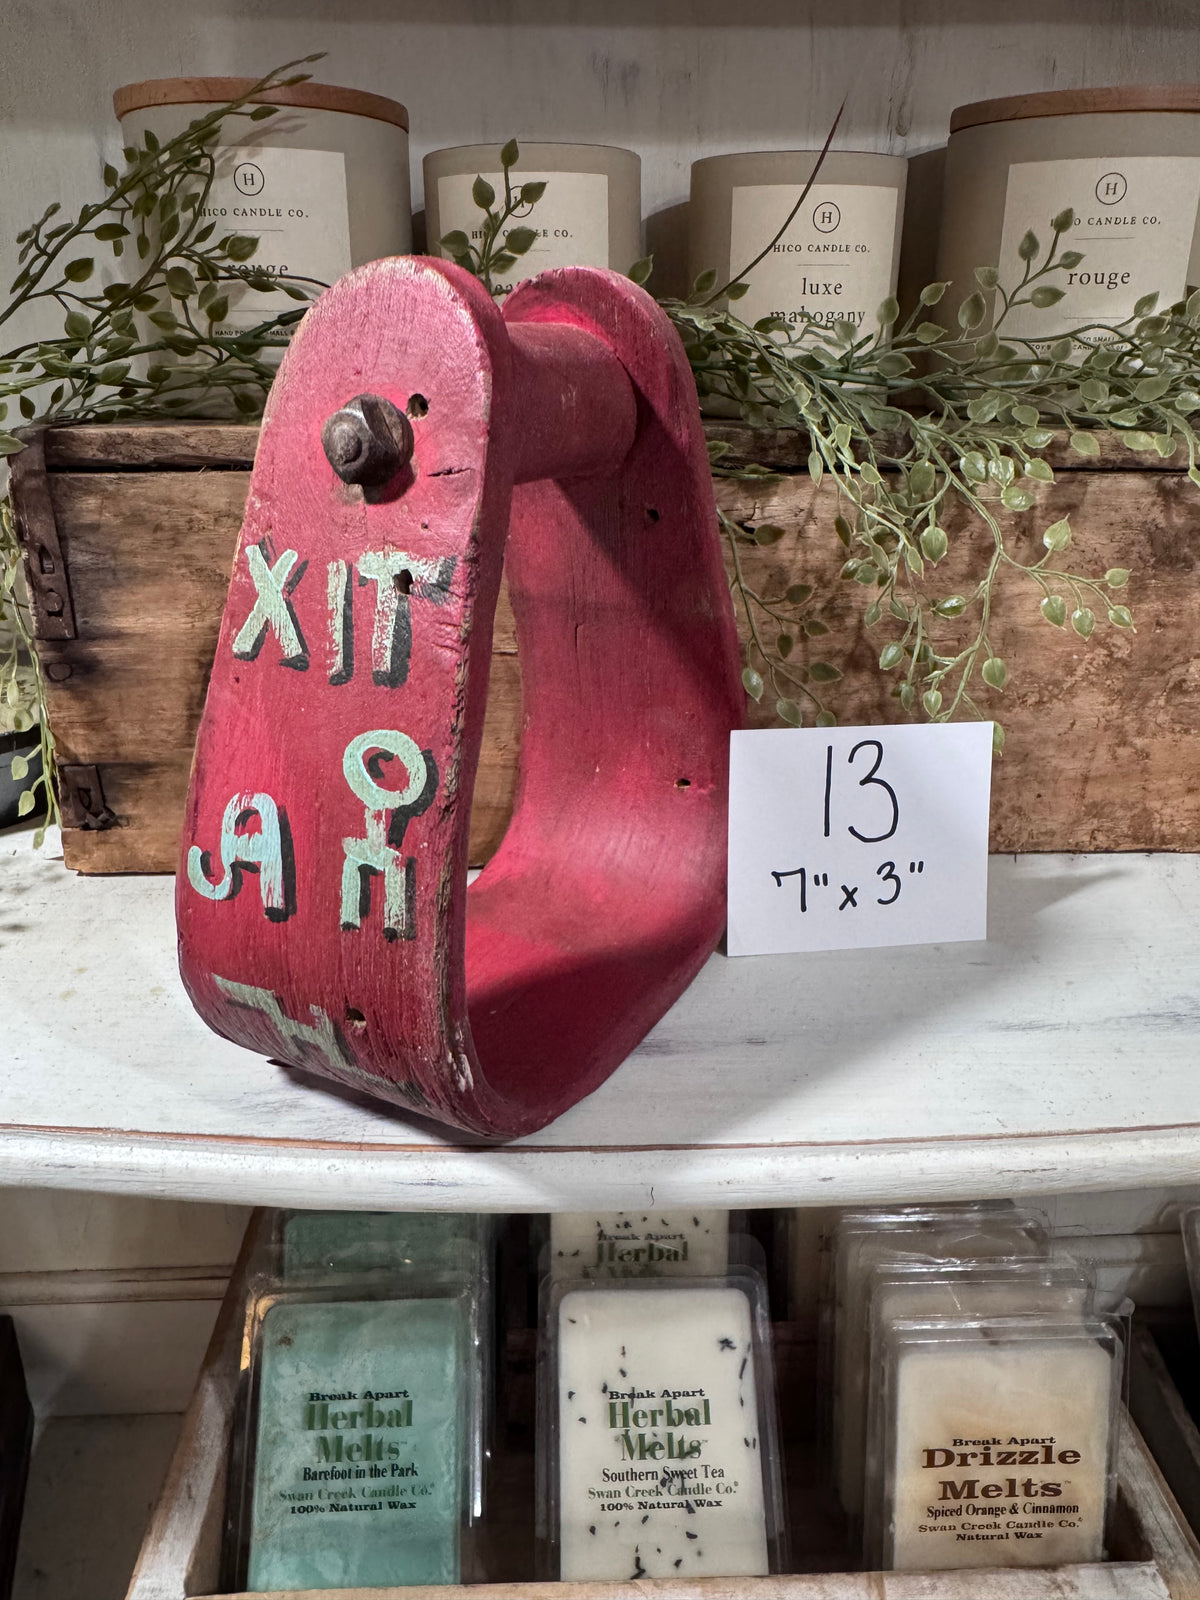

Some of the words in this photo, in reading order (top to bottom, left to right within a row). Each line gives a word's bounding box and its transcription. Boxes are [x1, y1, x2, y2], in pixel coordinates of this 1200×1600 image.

[233, 207, 282, 217] CANDLE
[288, 209, 309, 219] CO.
[1087, 216, 1137, 226] CANDLE
[1142, 216, 1161, 225] CO.
[554, 229, 573, 239] CO.
[773, 244, 802, 253] HICO
[807, 244, 851, 253] CANDLE
[855, 244, 871, 253] CO.
[801, 277, 843, 296] luxe
[1067, 271, 1131, 290] rouge
[231, 538, 457, 687] XIT
[823, 739, 899, 843] 13
[597, 1240, 688, 1263] Herbal
[308, 1391, 358, 1401] Break
[363, 1389, 410, 1401] Apart
[608, 1389, 656, 1400] Break
[661, 1388, 705, 1400] Apart
[305, 1399, 413, 1431] Herbal
[608, 1399, 712, 1429] Herbal
[952, 1437, 1001, 1447] Break
[1007, 1435, 1057, 1447] Apart
[922, 1445, 1081, 1469] Drizzle
[303, 1466, 351, 1481] Barefoot
[355, 1465, 366, 1479] in
[369, 1463, 388, 1478] the
[391, 1462, 419, 1477] Park
[602, 1467, 659, 1483] Southern
[662, 1465, 698, 1480] Sweet
[701, 1464, 725, 1479] Tea
[318, 1486, 356, 1499] Creek
[588, 1487, 622, 1500] Swan
[625, 1484, 663, 1498] Creek
[667, 1482, 712, 1497] Candle
[290, 1504, 325, 1514] 100%
[329, 1501, 383, 1512] Natural
[387, 1500, 416, 1509] Wax
[600, 1502, 634, 1512] 100%
[637, 1499, 690, 1511] Natural
[693, 1498, 723, 1508] Wax
[927, 1504, 963, 1521] Spiced
[965, 1502, 1007, 1519] Orange
[1008, 1502, 1019, 1515] &
[1023, 1502, 1079, 1515] Cinnamon
[918, 1523, 957, 1533] Swan
[961, 1521, 1001, 1531] Creek
[1006, 1520, 1055, 1530] Candle
[956, 1531, 1010, 1542] Natural
[1014, 1531, 1043, 1540] Wax
